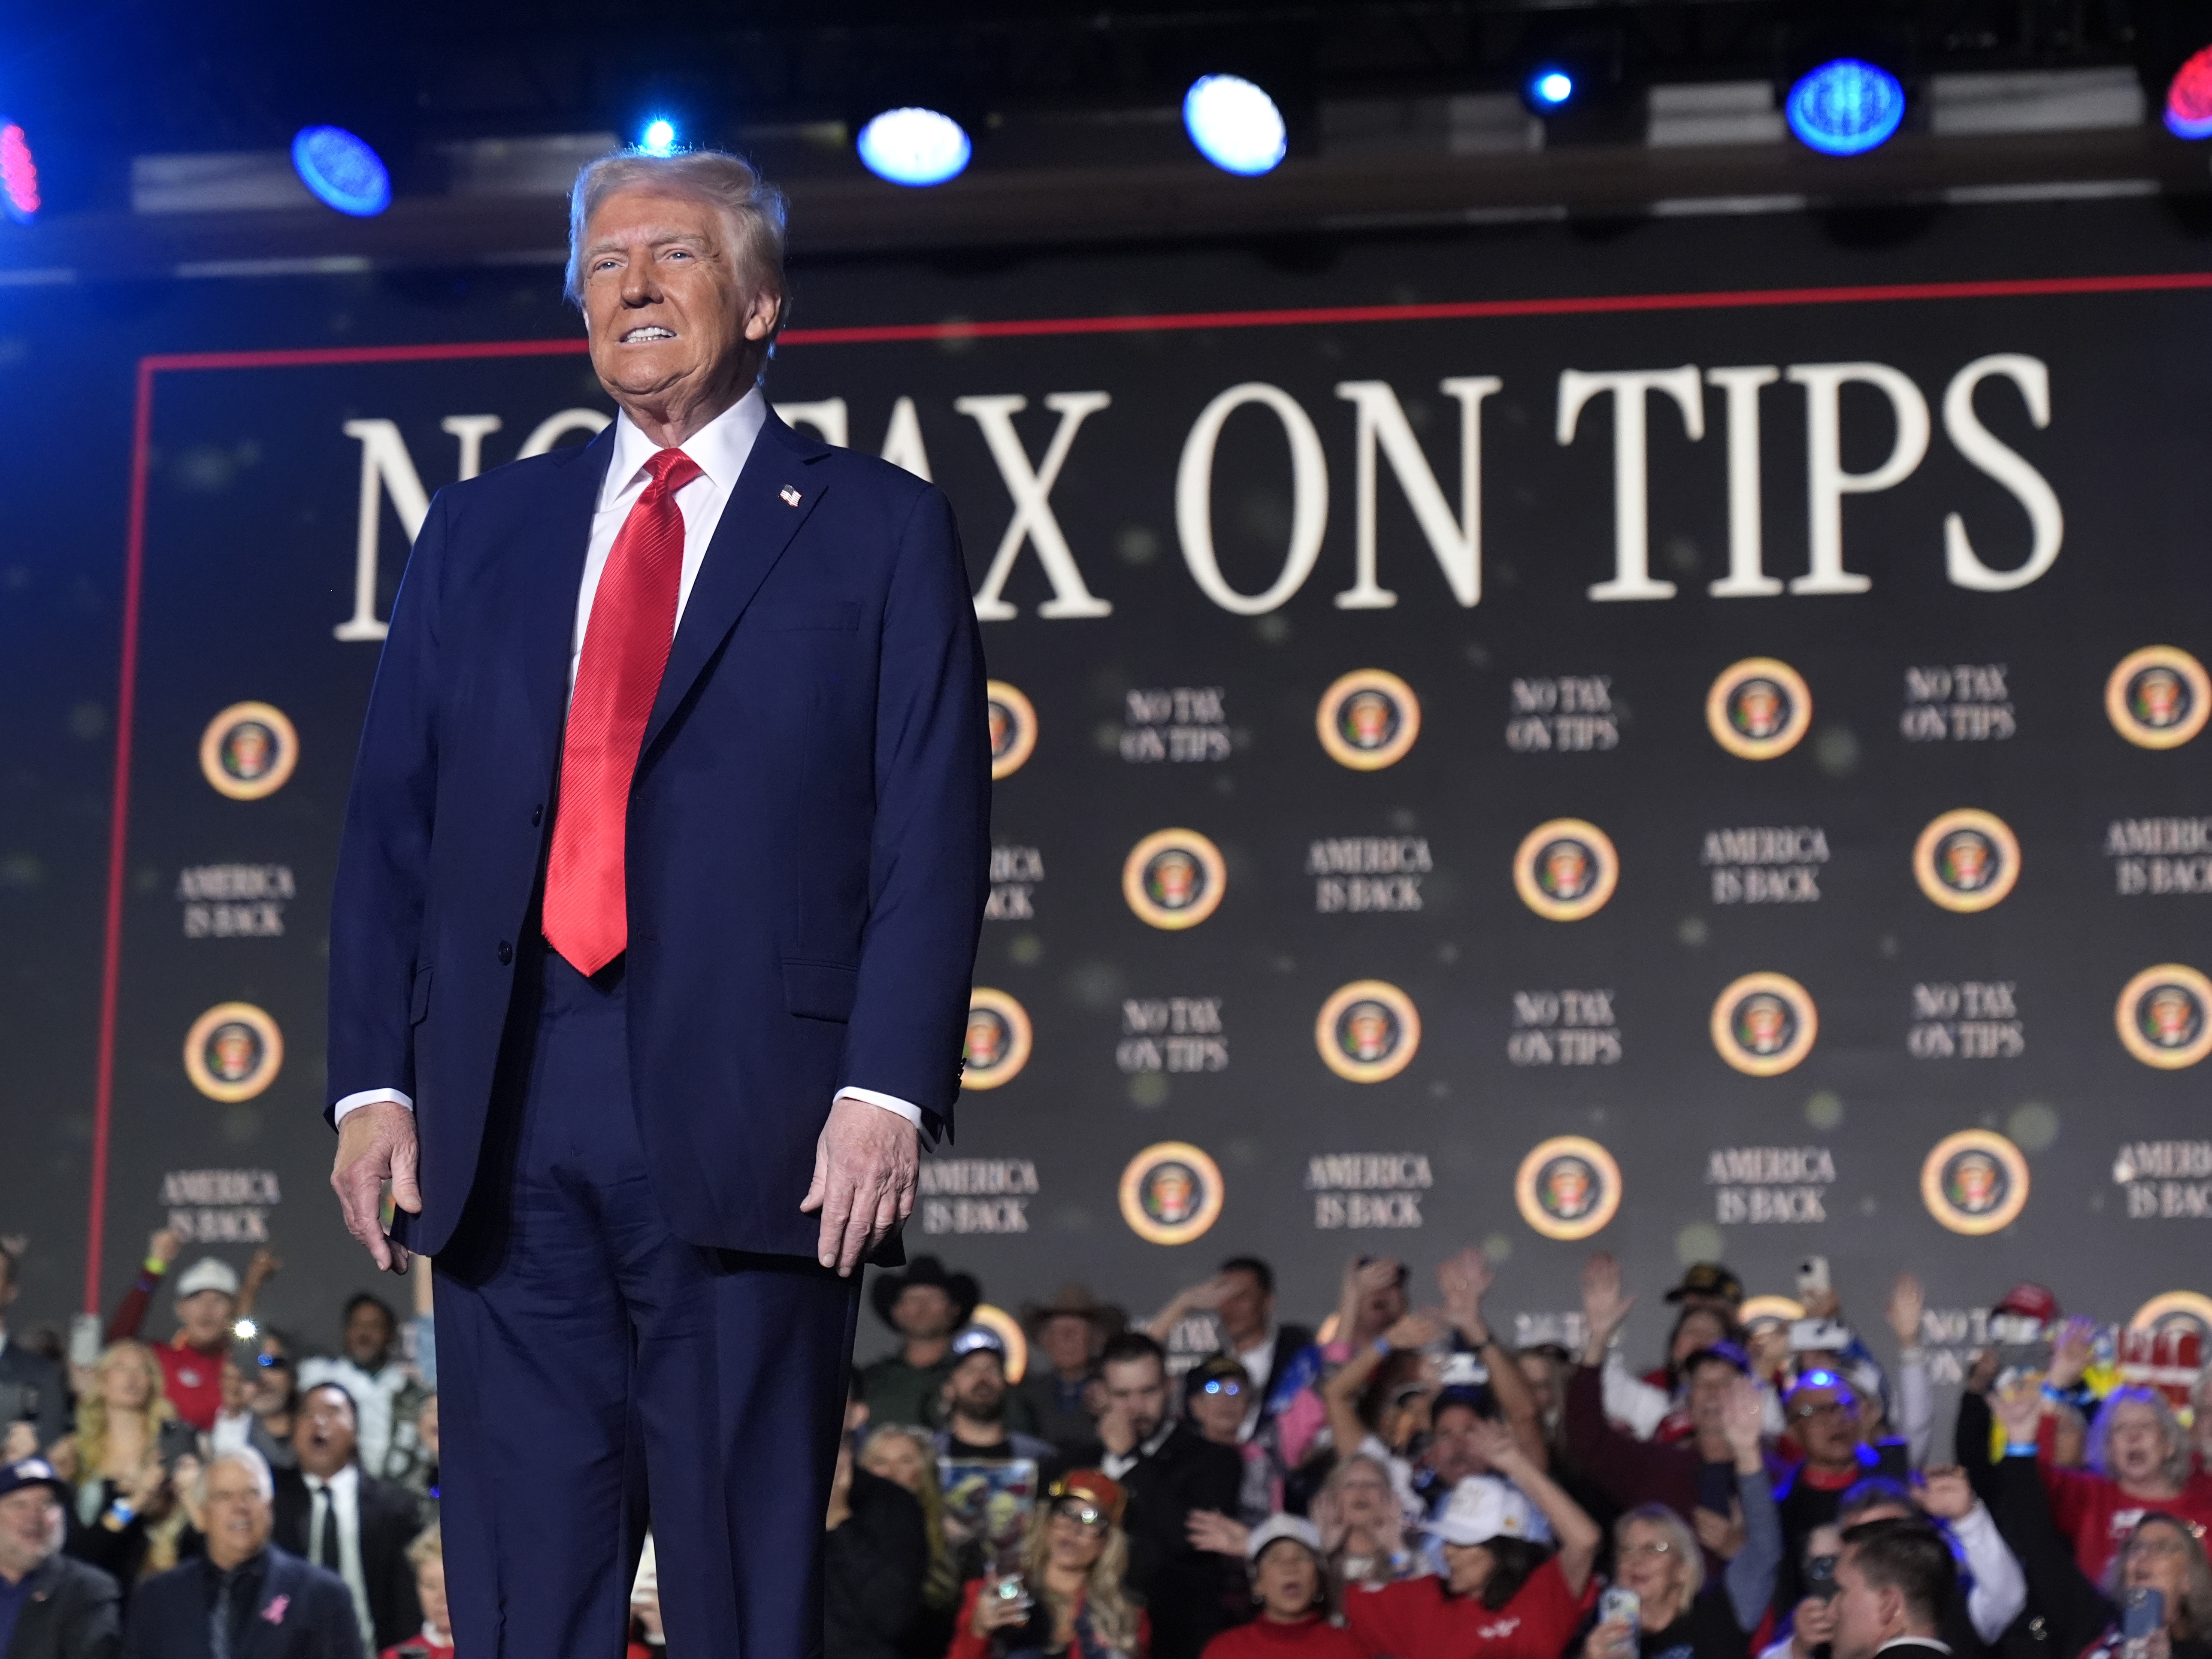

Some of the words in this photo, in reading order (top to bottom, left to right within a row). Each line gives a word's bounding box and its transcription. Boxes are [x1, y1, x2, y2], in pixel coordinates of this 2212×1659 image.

[333, 405, 621, 642] N
[1176, 376, 1501, 615] ON
[1557, 354, 2064, 601] TIPS
[1511, 677, 1557, 713] NO
[1558, 677, 1612, 712] TAX
[1905, 666, 1952, 704] NO
[1952, 665, 2008, 702] TAX
[1126, 689, 1172, 725] NO
[1173, 687, 1225, 724] TAX
[1900, 704, 1949, 741] ON
[1949, 702, 2015, 740] TIPS
[1119, 727, 1168, 763] ON
[1168, 724, 1231, 761] TIPS
[1506, 715, 1554, 752] ON
[1554, 713, 1619, 751] TIPS
[1307, 837, 1433, 875] AMERICA
[1701, 827, 1831, 864] AMERICA
[176, 864, 295, 901] AMERICA
[1317, 878, 1347, 912] IS
[1347, 876, 1422, 911] BACK
[1712, 868, 1743, 903] IS
[1743, 867, 1820, 903] BACK
[2117, 858, 2148, 894] IS
[184, 903, 211, 938] IS
[211, 902, 283, 937] BACK
[1123, 999, 1169, 1035] NO
[1169, 998, 1222, 1034] TAX
[1513, 990, 1559, 1028] NO
[1560, 990, 1615, 1026] TAX
[1912, 983, 1960, 1020] NO
[1961, 982, 2017, 1018] TAX
[1116, 1037, 1164, 1073] ON
[1165, 1036, 1228, 1072] TIPS
[1507, 1029, 1555, 1066] ON
[1555, 1029, 1622, 1065] TIPS
[1907, 1021, 1956, 1059] ON
[1958, 1022, 2024, 1058] TIPS
[917, 1159, 1039, 1195] AMERICA
[1304, 1153, 1434, 1190] AMERICA
[1706, 1147, 1837, 1184] AMERICA
[160, 1169, 281, 1204] AMERICA
[1717, 1187, 1746, 1223] IS
[1746, 1187, 1826, 1223] BACK
[2126, 1181, 2159, 1219] IS
[196, 1208, 268, 1242] BACK
[923, 1199, 953, 1234] IS
[953, 1198, 1028, 1233] BACK
[1316, 1193, 1346, 1228] IS
[1346, 1193, 1422, 1228] BACK
